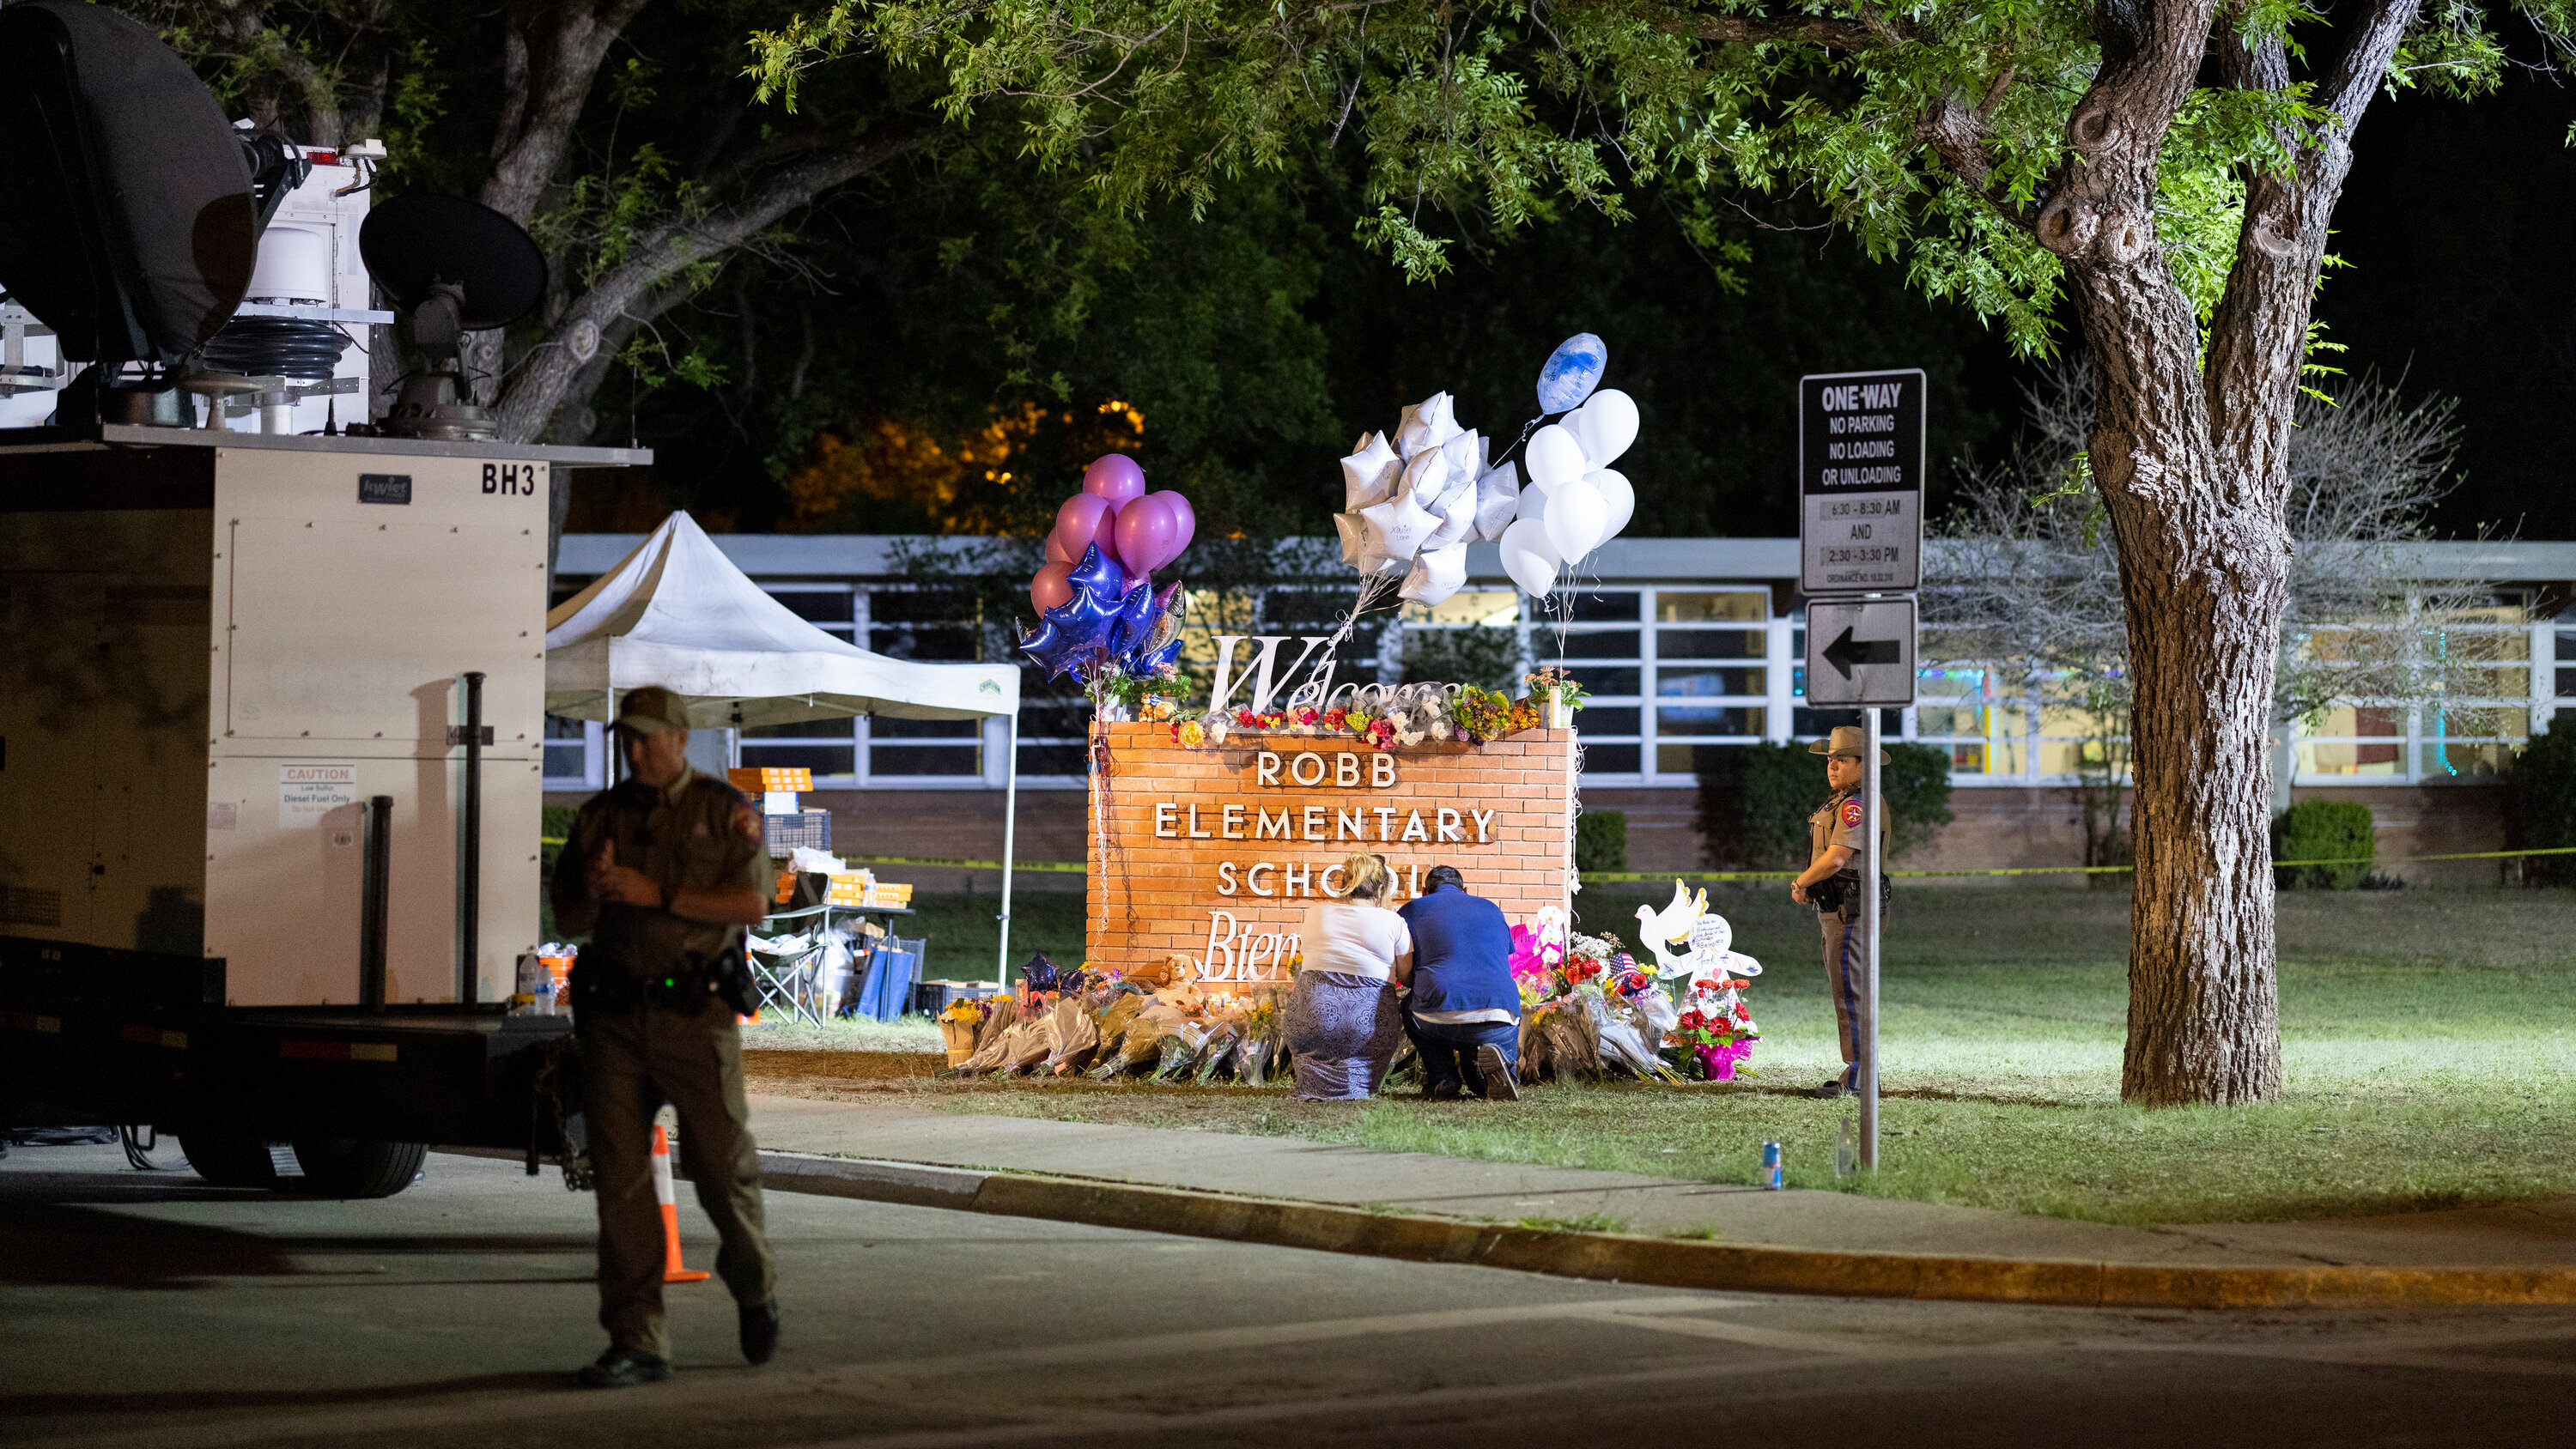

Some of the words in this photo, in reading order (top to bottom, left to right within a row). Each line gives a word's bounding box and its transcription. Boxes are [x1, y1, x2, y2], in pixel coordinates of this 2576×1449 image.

[1822, 385, 1859, 411] ONE
[1863, 383, 1902, 409] WAY
[1830, 416, 1846, 434] NO
[1848, 414, 1894, 433] PARKING
[1830, 442, 1846, 460] NO
[1847, 440, 1894, 459] LOADING
[483, 464, 534, 495] BH3
[1822, 469, 1838, 486] OR
[1840, 465, 1901, 485] UNLOADING
[1860, 502, 1881, 515] 8:30
[1885, 500, 1900, 515] AM
[1850, 524, 1872, 540] AND
[1829, 550, 1850, 561] 2:30
[1860, 549, 1880, 561] 3:30
[1884, 547, 1899, 562] PM
[288, 769, 349, 779] CAUTION
[1258, 751, 1396, 787] ROBB
[331, 795, 350, 803] Only
[1156, 803, 1494, 843] ELEMENTARY
[1217, 861, 1423, 899] SCHOL
